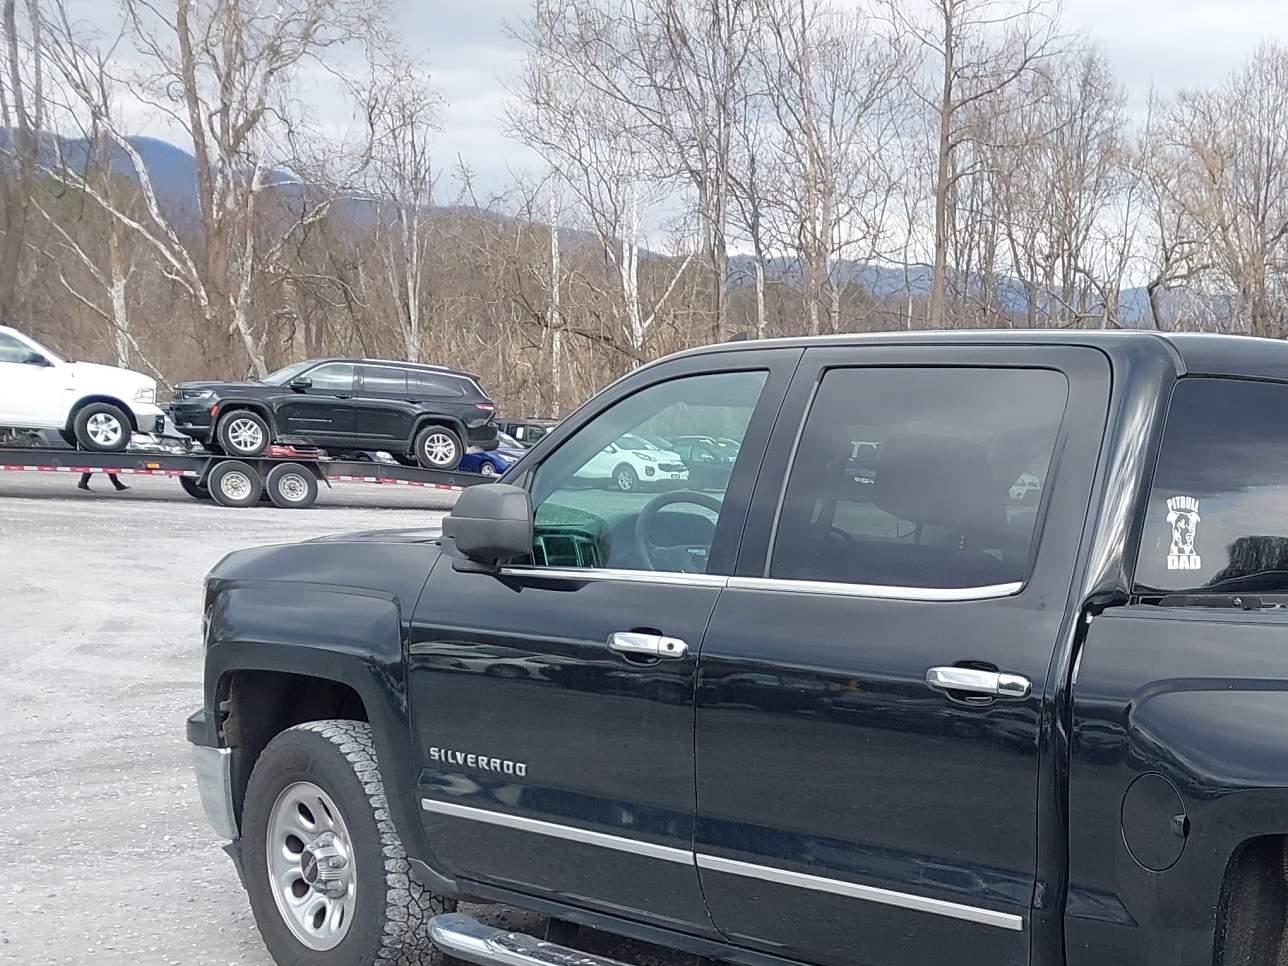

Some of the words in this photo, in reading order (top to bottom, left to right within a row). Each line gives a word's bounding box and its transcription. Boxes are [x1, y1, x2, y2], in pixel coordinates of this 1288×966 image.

[1166, 496, 1199, 512] PITBULL
[1167, 555, 1201, 570] DAD
[429, 746, 527, 777] SILVERADO
